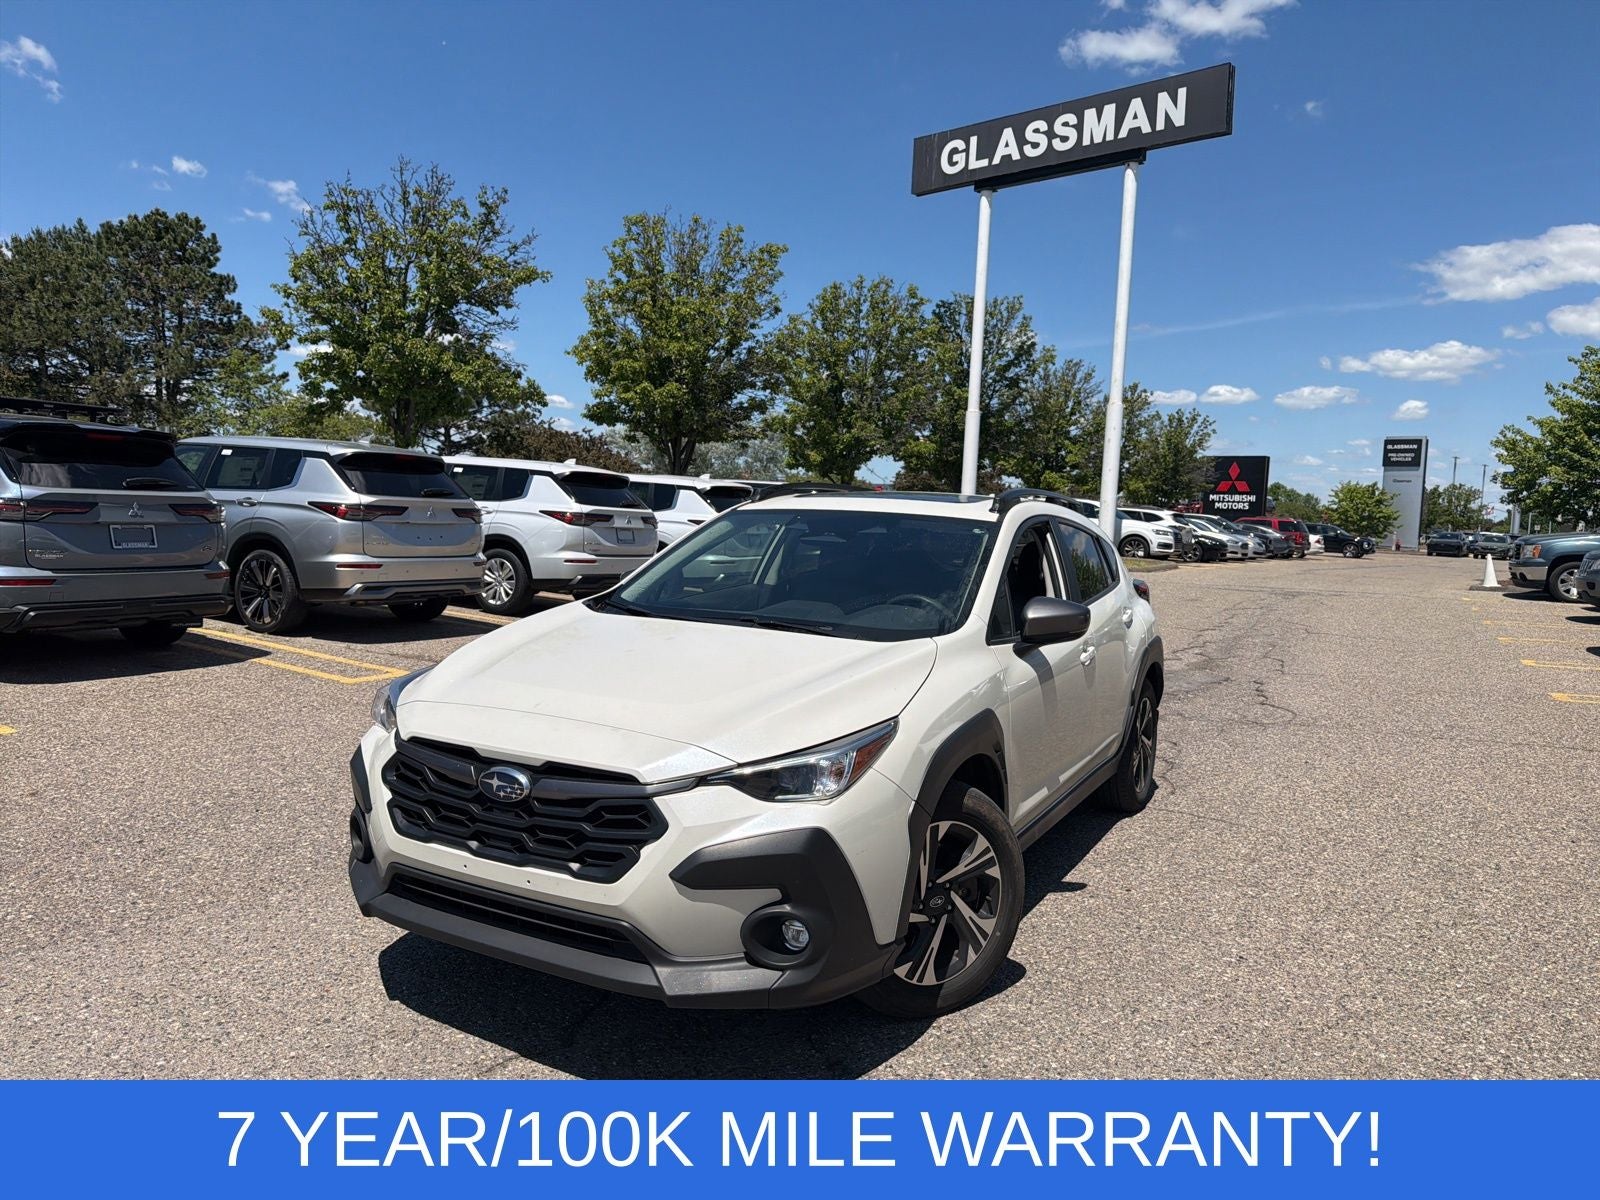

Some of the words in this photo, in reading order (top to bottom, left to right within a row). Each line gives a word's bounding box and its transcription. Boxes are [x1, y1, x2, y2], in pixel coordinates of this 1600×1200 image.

[940, 86, 1187, 175] GLASSMAN
[1209, 494, 1256, 502] MITSUBISHI
[1214, 502, 1249, 510] MOTORS
